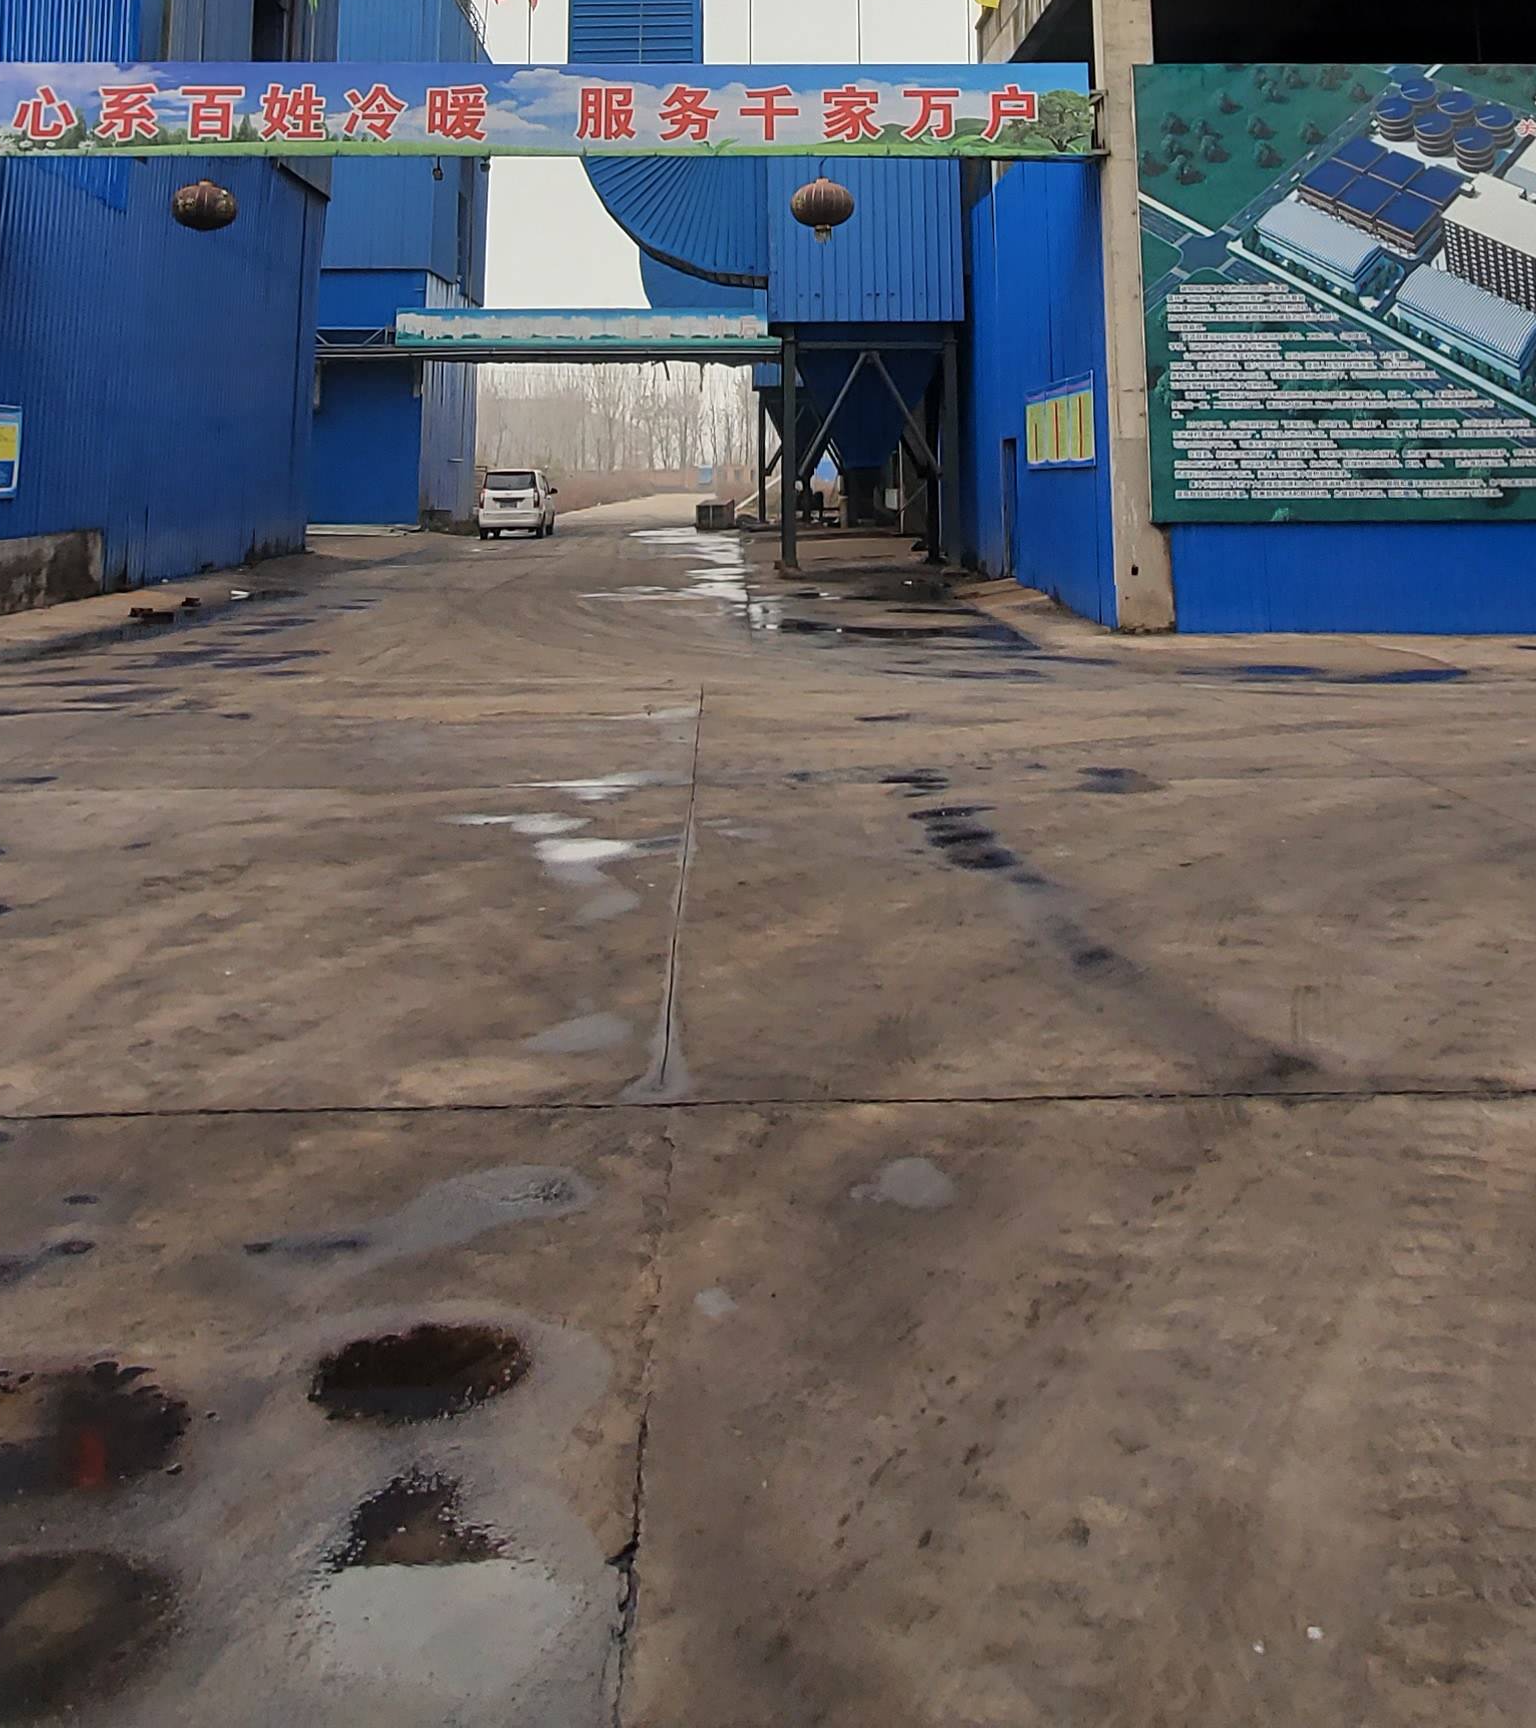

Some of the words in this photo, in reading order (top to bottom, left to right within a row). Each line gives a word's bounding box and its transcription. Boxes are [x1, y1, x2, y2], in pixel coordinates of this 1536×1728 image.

[12, 83, 489, 142] 心系百姓冷暖
[576, 83, 1040, 143] 服务千家万户
